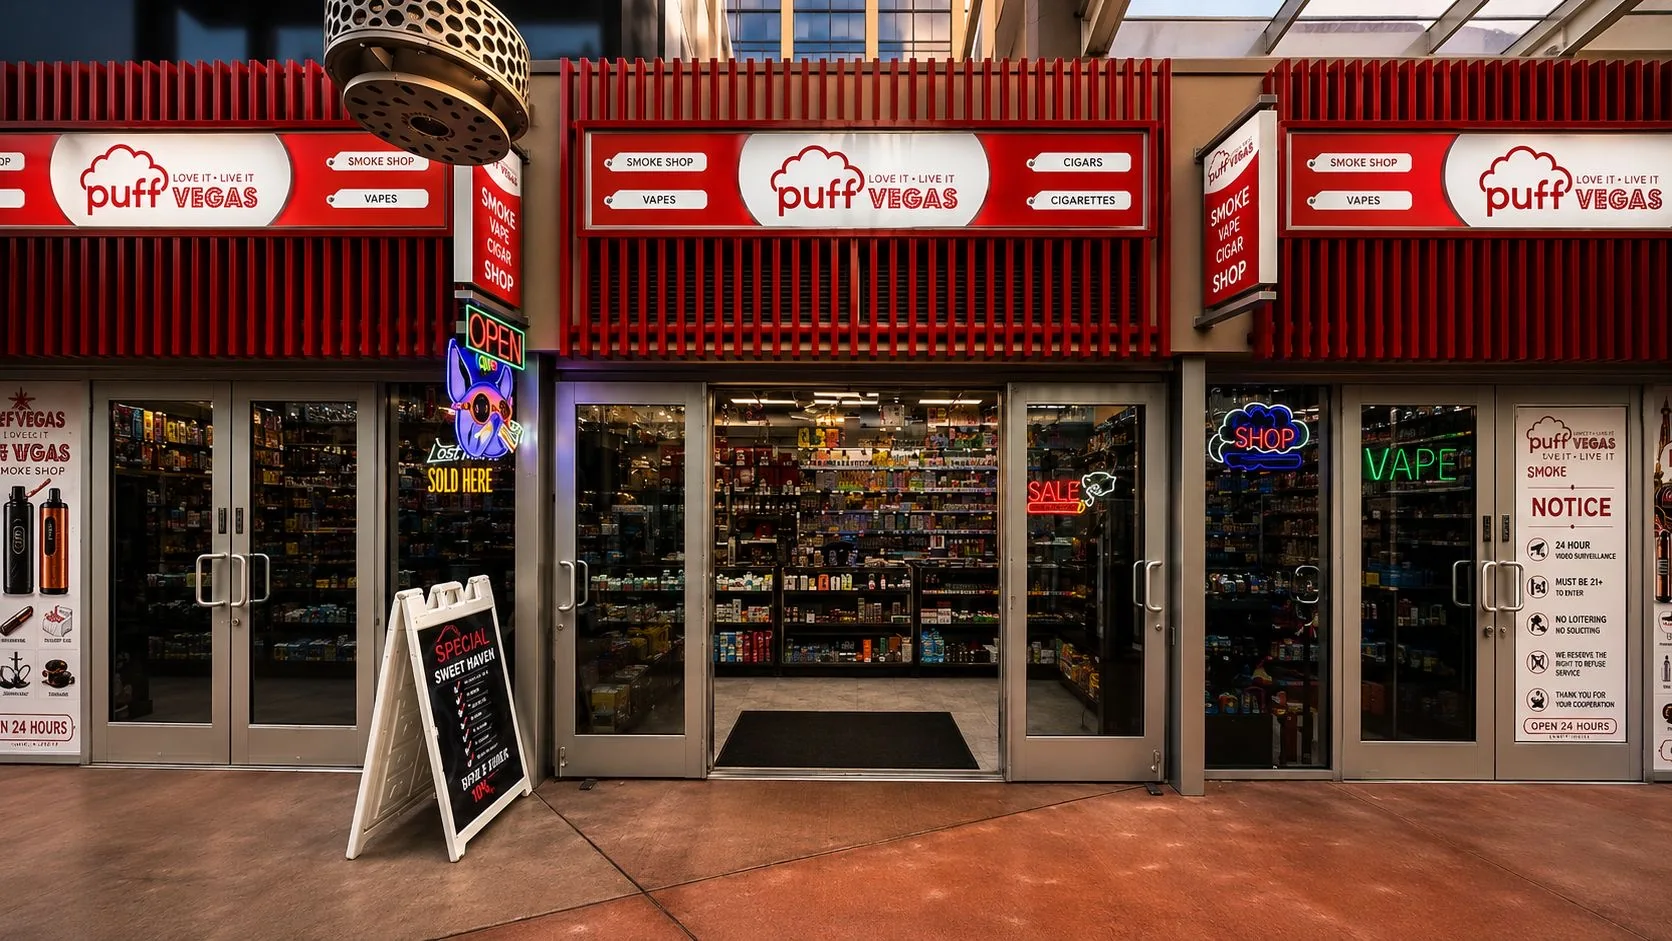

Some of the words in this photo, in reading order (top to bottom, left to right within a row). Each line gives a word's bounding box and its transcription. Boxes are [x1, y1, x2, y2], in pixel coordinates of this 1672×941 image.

[348, 156, 388, 167] SMOKE
[390, 156, 415, 167] SHOP
[626, 157, 663, 168] SMOKE
[665, 157, 694, 168] SHOP
[1063, 157, 1103, 168] CIGARS
[1330, 157, 1367, 168] SMOKE
[1369, 157, 1398, 168] SHOP
[173, 173, 200, 183] LOVE
[201, 173, 212, 183] IT
[220, 173, 243, 183] LIVE
[245, 173, 255, 183] IT
[869, 174, 897, 184] LOVE
[899, 174, 910, 184] IT
[918, 174, 943, 184] LIVE
[945, 174, 955, 184] IT
[1576, 175, 1603, 185] LOVE
[1605, 175, 1614, 185] IT
[1625, 175, 1648, 185] LIVE
[1649, 175, 1659, 185] IT
[88, 178, 161, 216] puff
[173, 187, 258, 208] VEGAS
[364, 194, 398, 204] VAPES
[642, 194, 676, 206] VAPES
[778, 178, 858, 217] puff
[868, 188, 958, 210] VEGAS
[1050, 194, 1116, 206] CIGARETTES
[1211, 185, 1250, 227] SMOKE
[1346, 195, 1381, 206] VAPES
[1487, 178, 1565, 217] puff
[1575, 188, 1663, 210] VEGAS
[481, 187, 516, 230] SMOKE
[489, 216, 509, 245] VAPE
[1218, 215, 1241, 242] VAPE
[487, 238, 512, 266] CIGAR
[1216, 236, 1244, 264] CIGAR
[484, 260, 514, 291] SHOP
[1213, 260, 1247, 293] SHOP
[469, 313, 522, 365] OPEN
[1234, 426, 1295, 450] SHOP
[1530, 432, 1569, 453] puff
[1572, 437, 1616, 449] VEGAS
[34, 466, 65, 475] SHOP
[1364, 447, 1458, 481] VAPE
[1527, 465, 1567, 478] SMOKE
[427, 467, 458, 493] SOLD
[462, 467, 493, 493] HERE
[1028, 481, 1081, 501] SALE
[1532, 497, 1612, 517] NOTICE
[1555, 541, 1566, 549] 24
[1567, 541, 1590, 549] HOUR
[1555, 577, 1577, 585] MUST
[1578, 577, 1588, 585] BE
[1555, 615, 1567, 623] NO
[1569, 615, 1607, 623] LOITERING
[435, 628, 490, 663] SPECIAL
[434, 660, 466, 684] SWEET
[12, 720, 27, 734] 24
[30, 720, 68, 735] HOURS
[1531, 722, 1558, 730] OPEN
[1561, 722, 1573, 730] 24
[1576, 722, 1610, 730] HOURS
